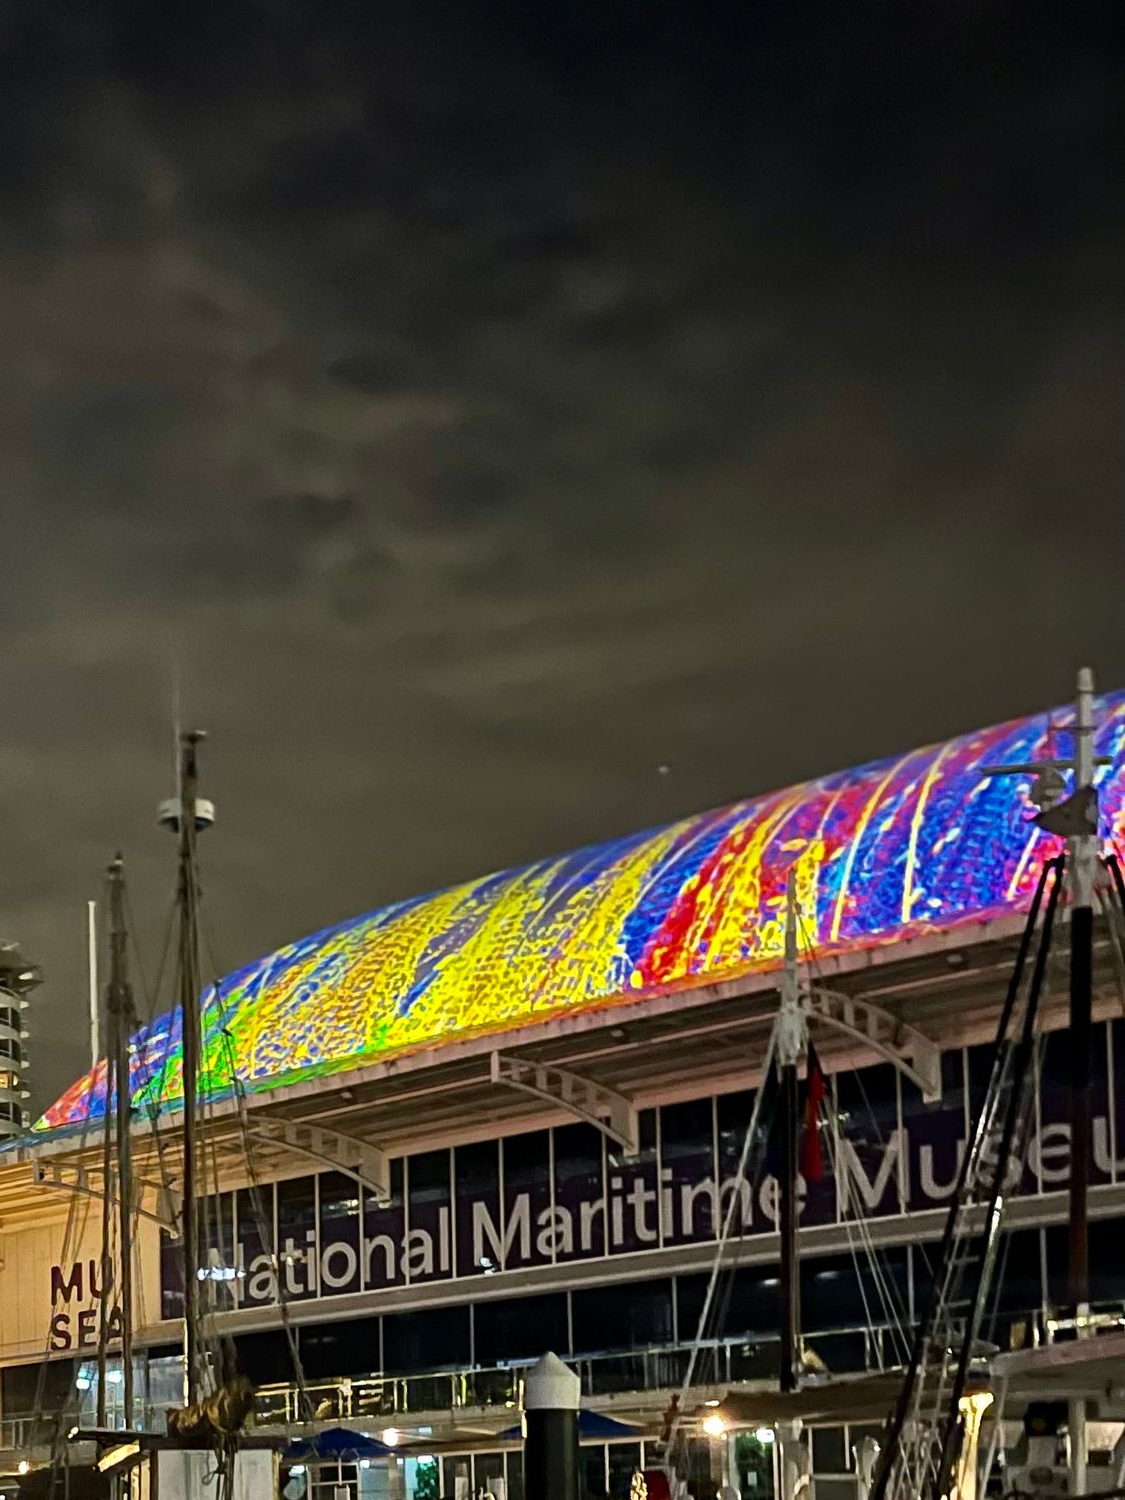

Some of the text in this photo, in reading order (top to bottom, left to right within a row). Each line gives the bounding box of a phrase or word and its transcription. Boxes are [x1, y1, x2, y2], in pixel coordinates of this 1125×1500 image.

[208, 1206, 450, 1306] National
[472, 1168, 808, 1267] Maritime
[50, 1305, 130, 1350] SEA
